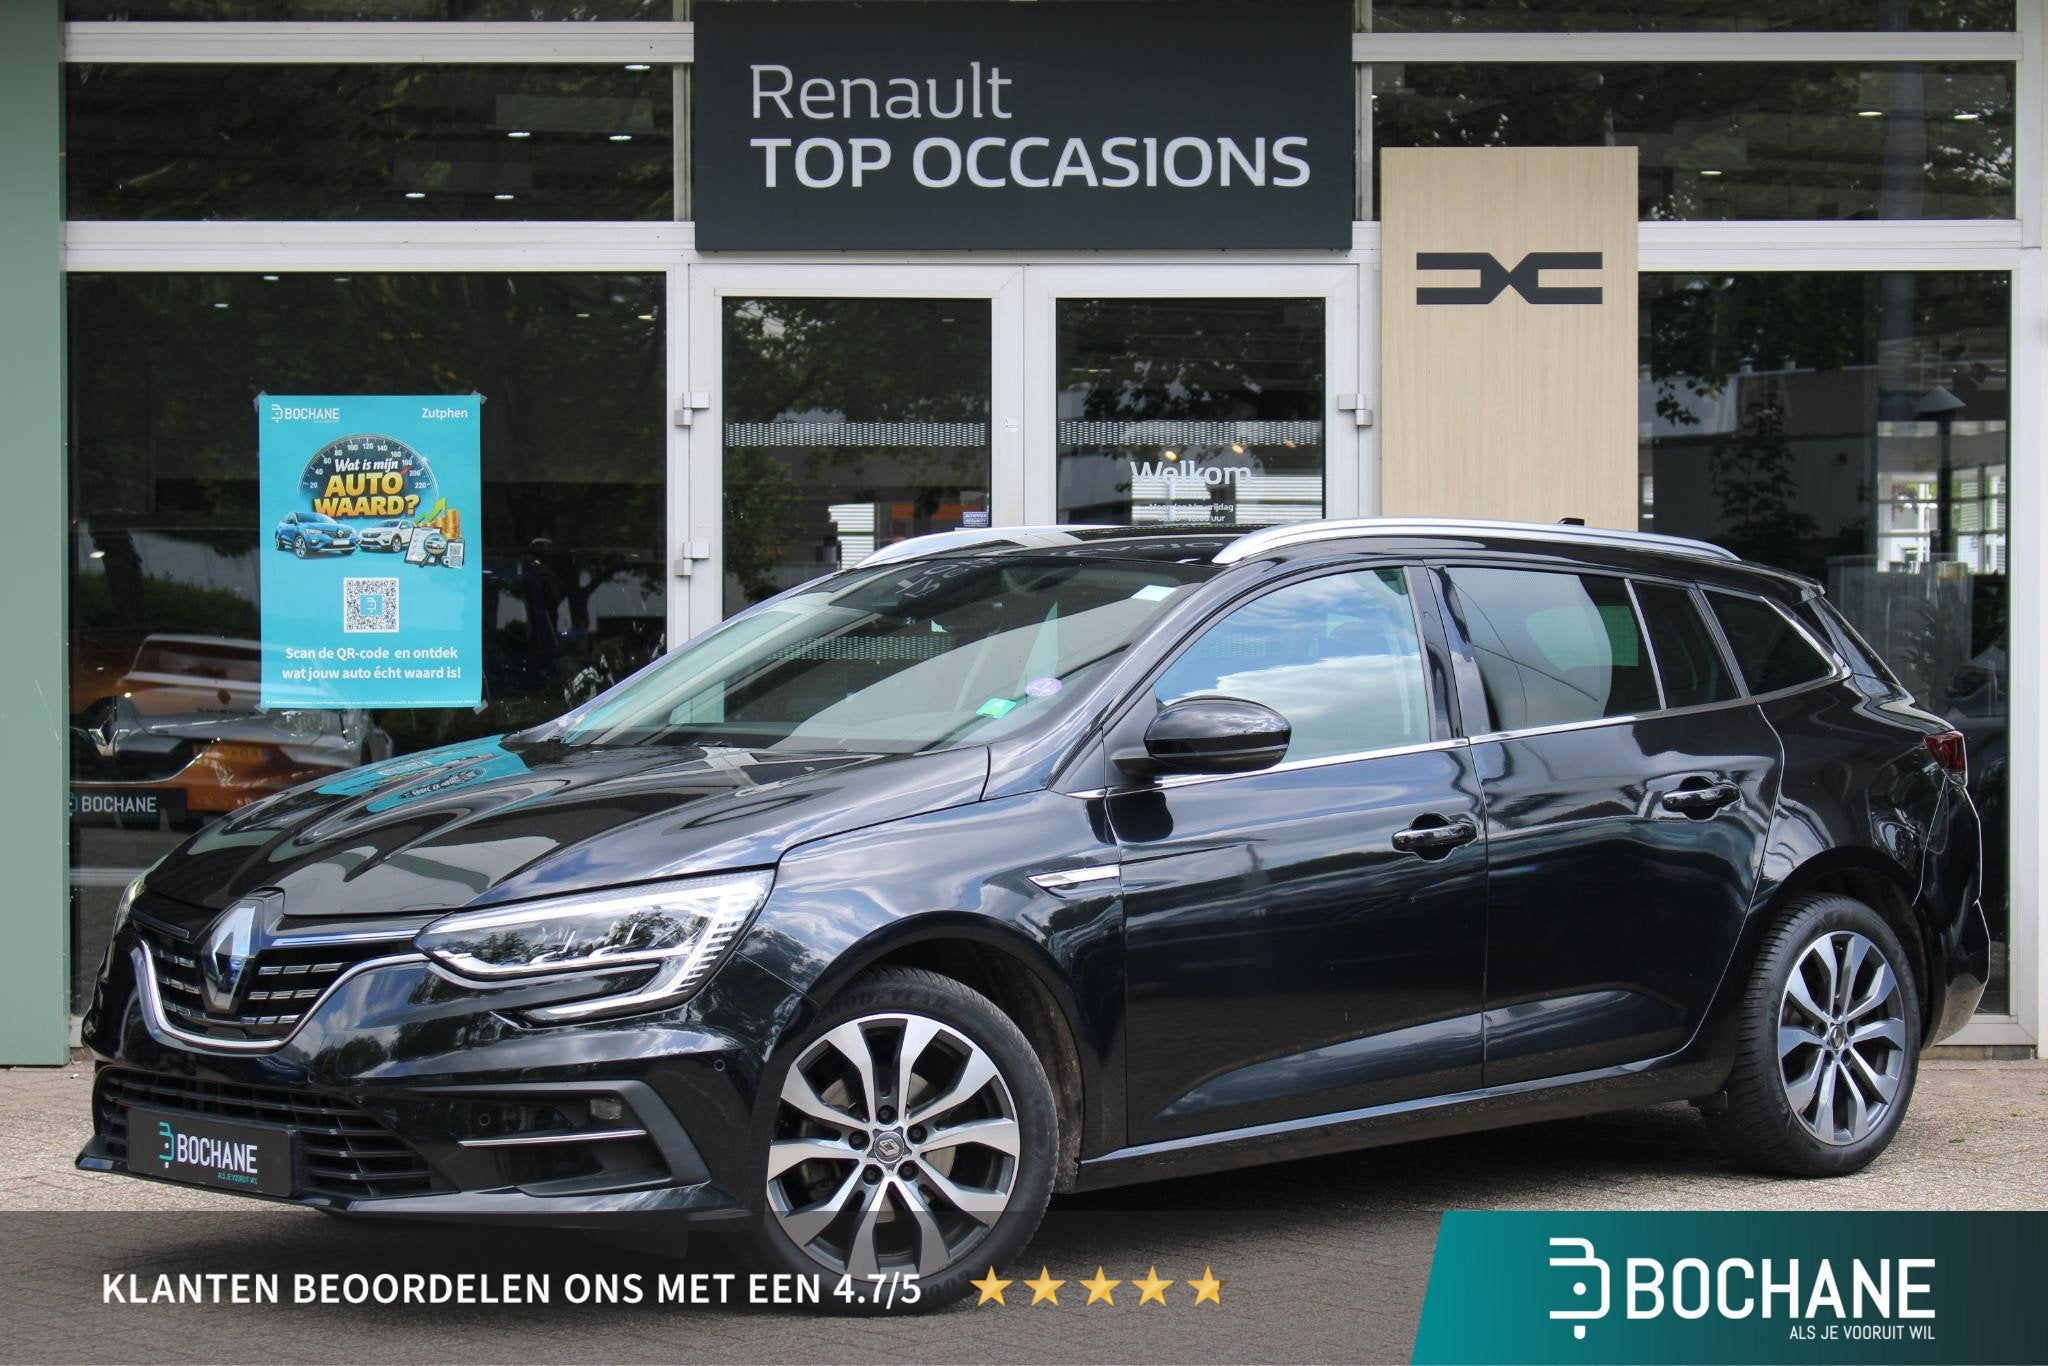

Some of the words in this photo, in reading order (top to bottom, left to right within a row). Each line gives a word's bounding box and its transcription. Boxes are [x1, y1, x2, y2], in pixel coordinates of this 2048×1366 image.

[751, 62, 1012, 118] Renault
[751, 138, 891, 188] TOP
[913, 137, 1310, 187] OCCASIONS
[284, 408, 340, 419] BOCHANE
[422, 407, 468, 421] Zutphen
[314, 468, 324, 476] 40
[334, 459, 360, 472] Wat
[362, 458, 371, 470] is
[373, 458, 398, 472] mijn
[1129, 460, 1251, 485] Welkom
[325, 473, 403, 497] AUTO
[314, 494, 420, 518] WAARD?
[285, 647, 315, 659] Scan
[318, 647, 333, 659] de
[337, 647, 389, 661] QR-code
[395, 650, 410, 659] en
[414, 647, 457, 659] ontdek
[282, 669, 306, 679] wat
[307, 669, 339, 682] jouw
[342, 669, 370, 679] auto
[374, 666, 401, 679] écht
[404, 667, 444, 679] waard
[447, 667, 461, 679] is!
[81, 796, 157, 813] BOCHANE
[177, 1133, 258, 1174] BOCHANE
